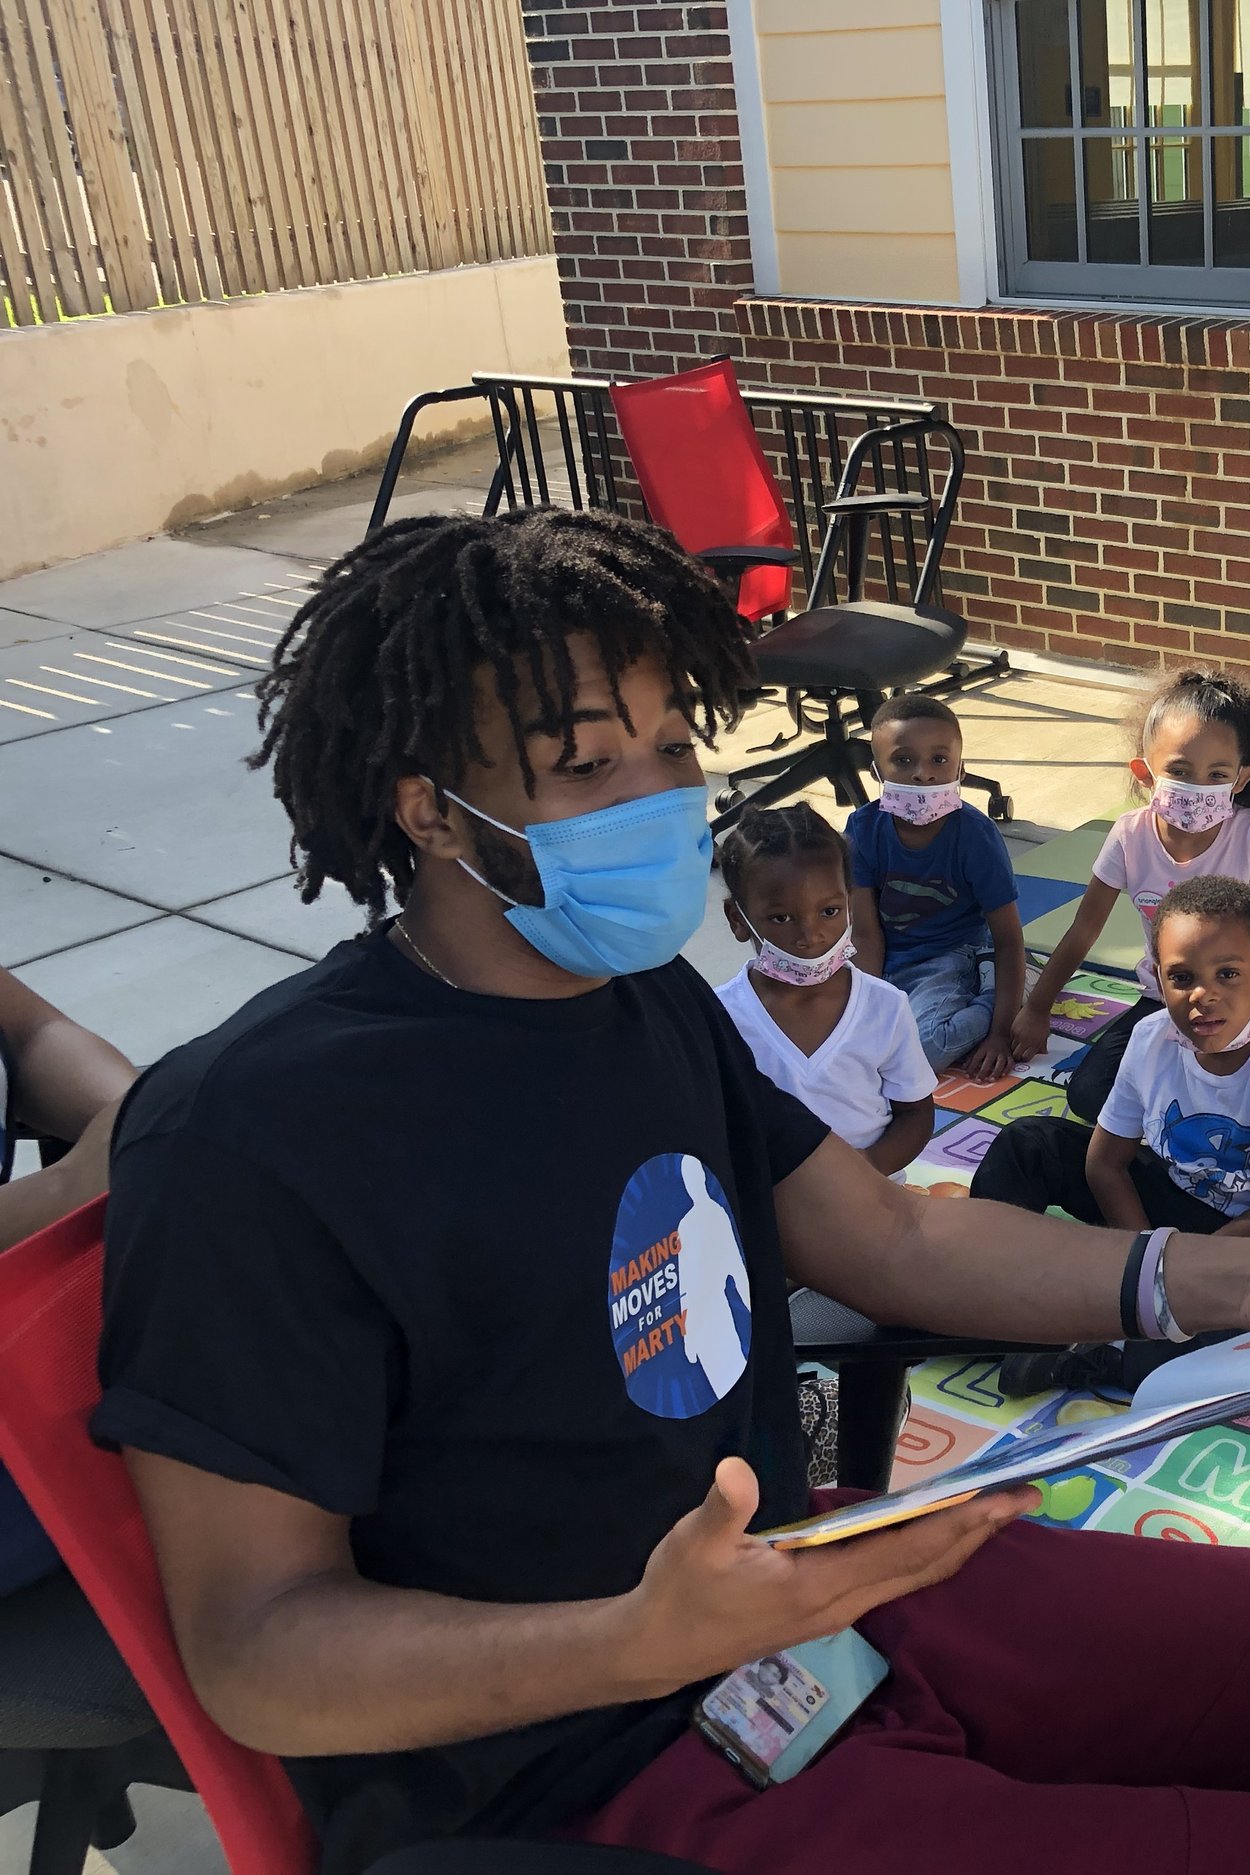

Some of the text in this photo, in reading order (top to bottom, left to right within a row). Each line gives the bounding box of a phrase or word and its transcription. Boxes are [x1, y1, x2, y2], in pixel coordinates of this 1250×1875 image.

[611, 1231, 682, 1296] MAKING
[611, 1262, 678, 1330] MOVES
[623, 1309, 687, 1376] MARTY
[638, 1306, 662, 1331] FOR
